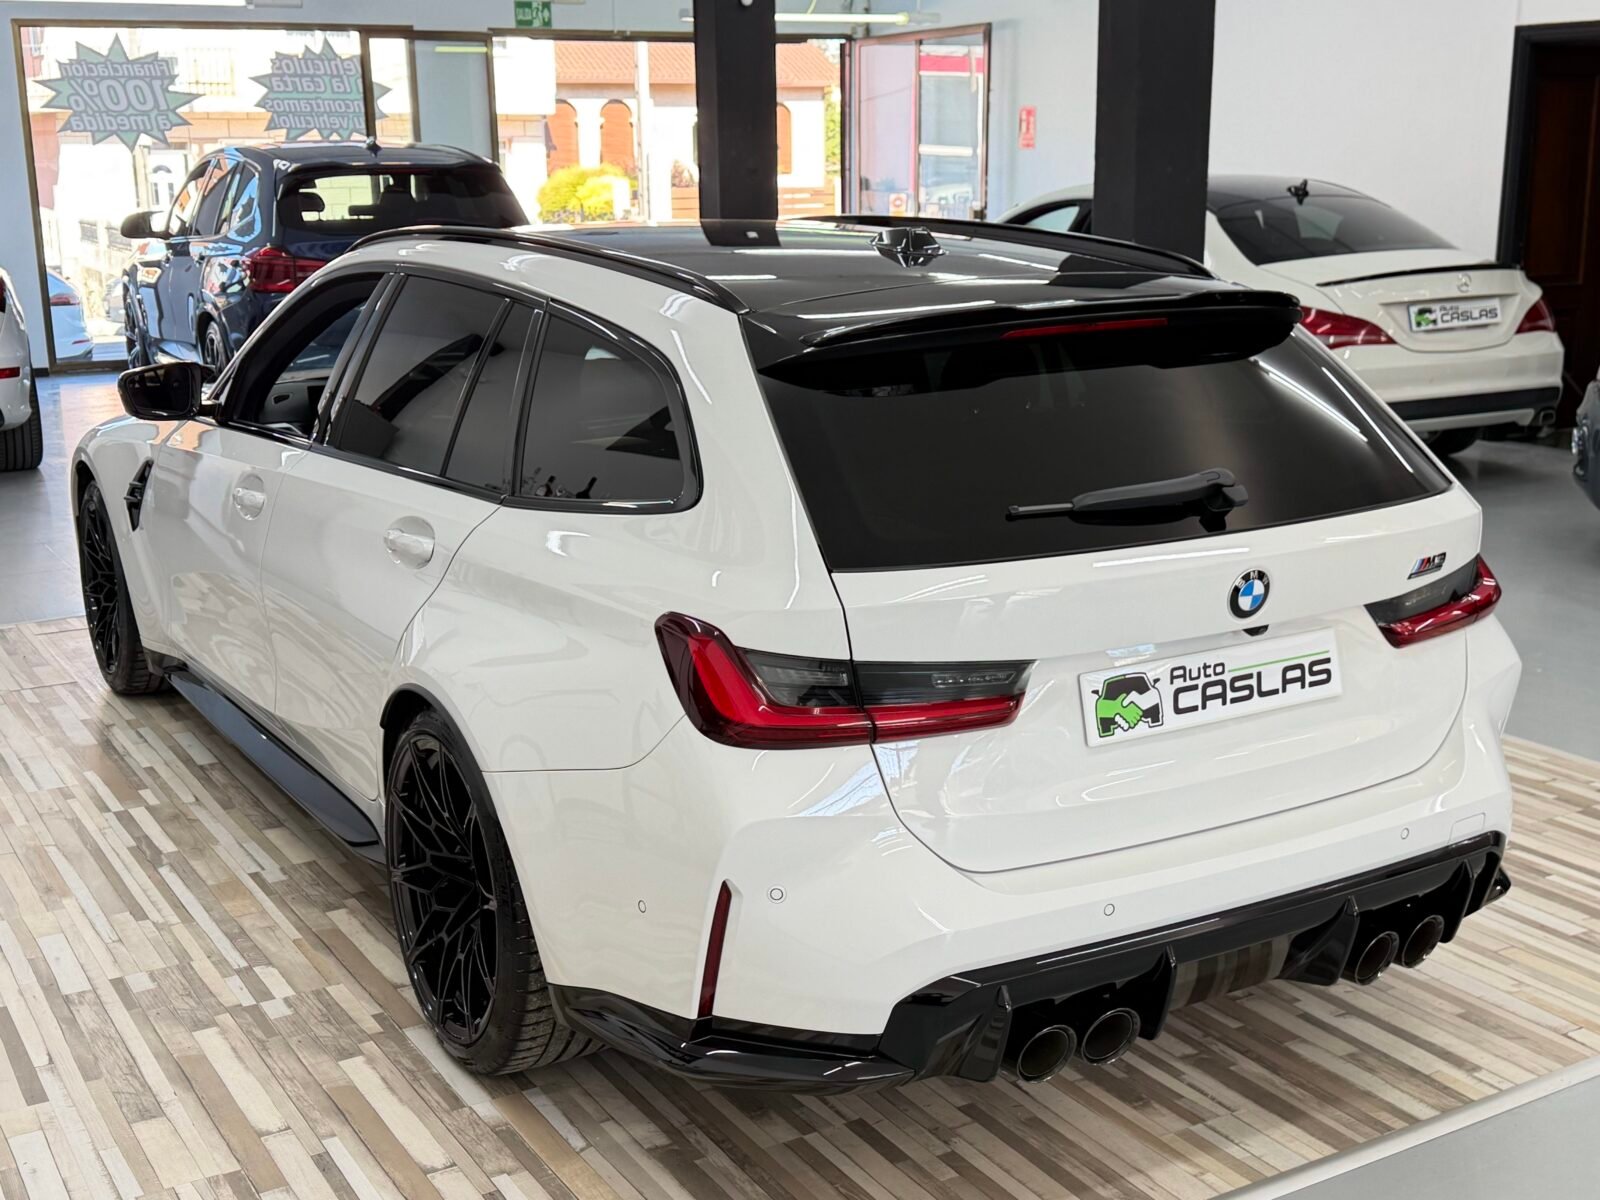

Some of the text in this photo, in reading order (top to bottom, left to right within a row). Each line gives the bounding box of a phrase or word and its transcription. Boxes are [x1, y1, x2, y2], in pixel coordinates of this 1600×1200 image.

[1439, 304, 1460, 313] Auto
[1440, 308, 1498, 324] CASLAS
[1235, 570, 1269, 588] BMW
[1169, 662, 1226, 685] Auto
[1172, 657, 1332, 716] CASLAS
